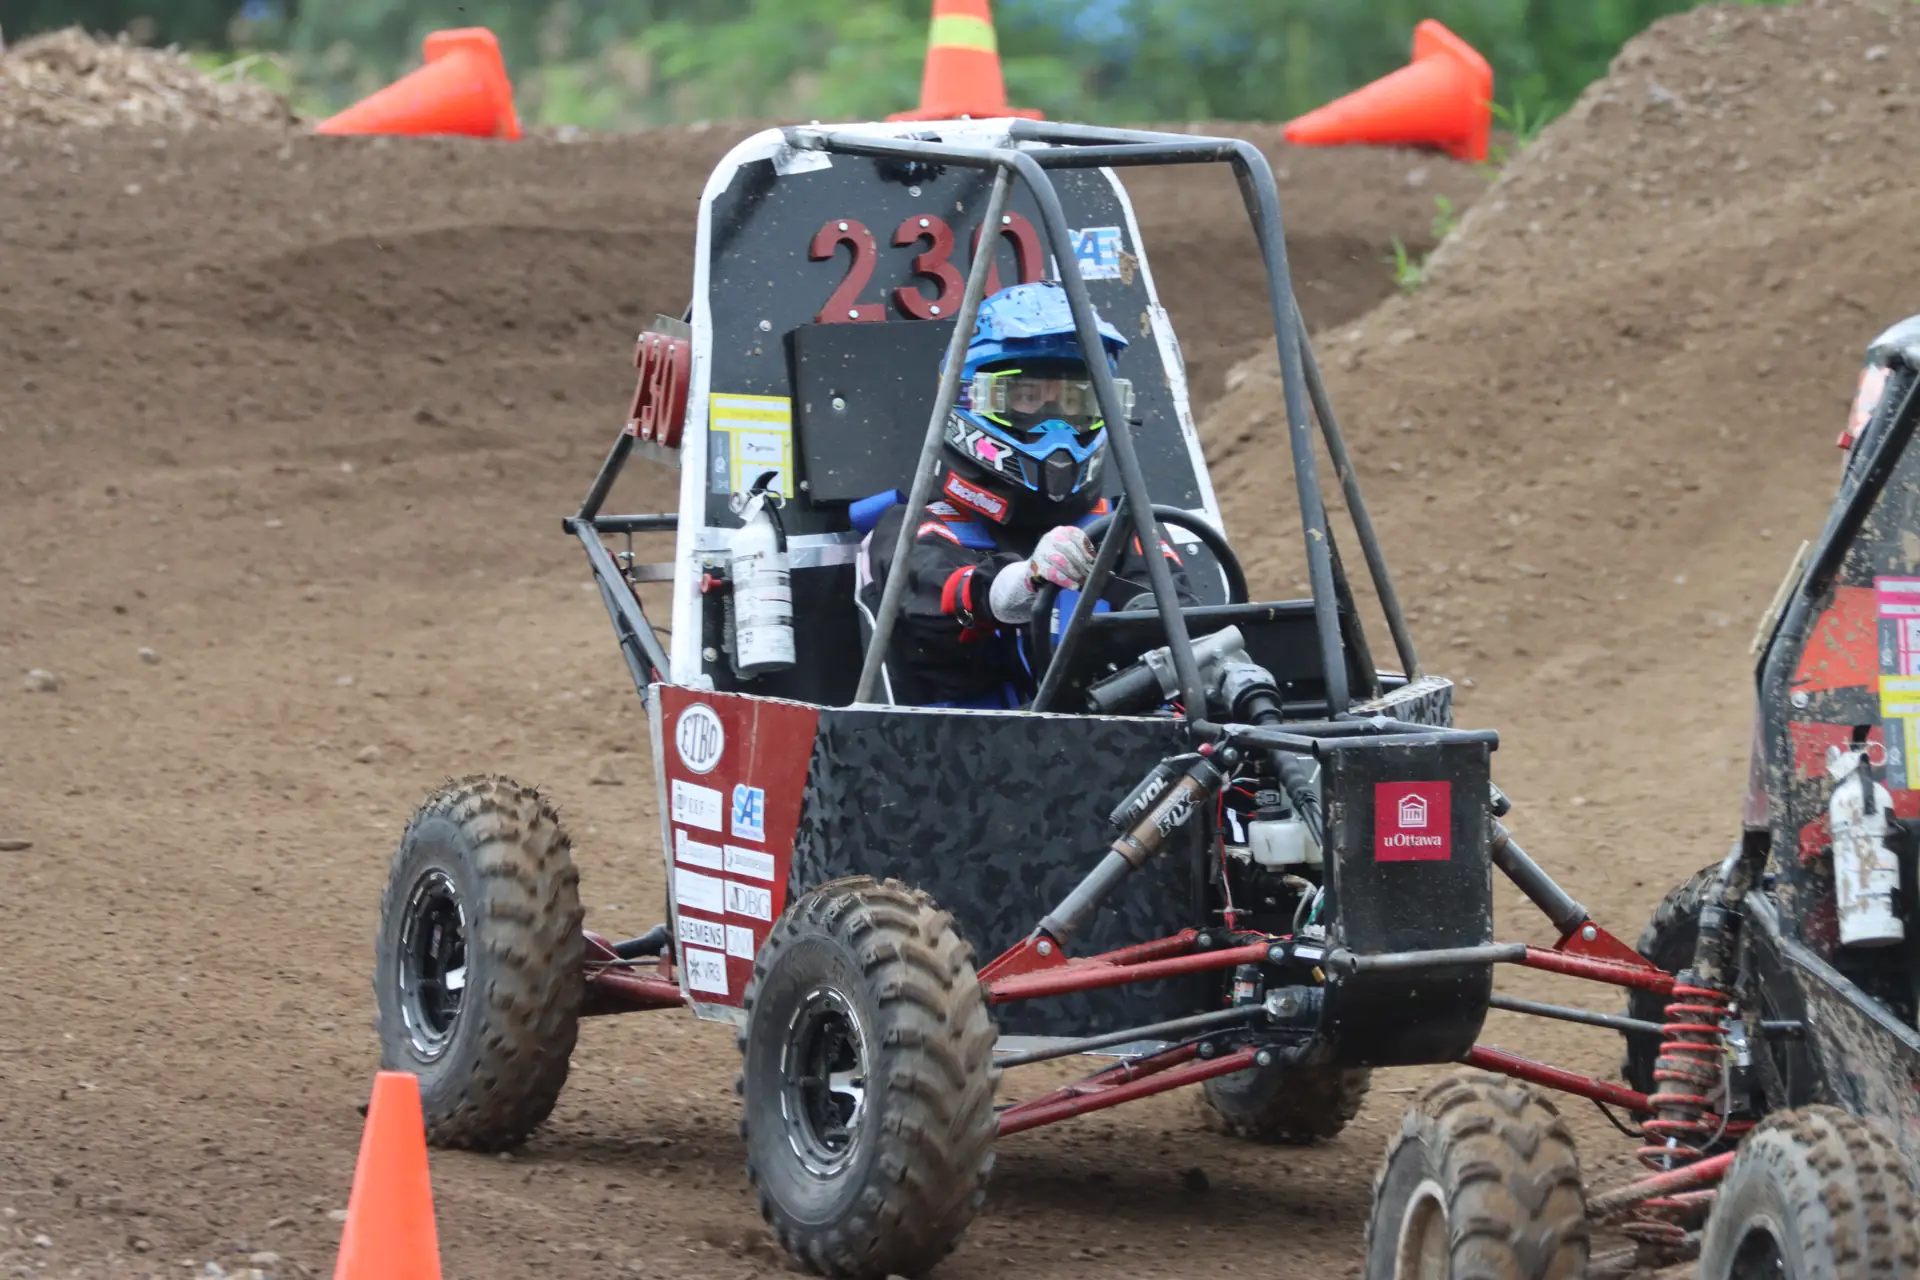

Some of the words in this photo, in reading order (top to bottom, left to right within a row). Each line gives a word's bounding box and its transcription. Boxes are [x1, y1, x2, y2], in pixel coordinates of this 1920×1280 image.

[808, 211, 1044, 323] 230
[624, 331, 687, 447] 230
[733, 786, 764, 827] SAE
[1157, 788, 1200, 838] FOX
[1384, 833, 1442, 848] uOttawa
[680, 920, 722, 946] SIEMENS
